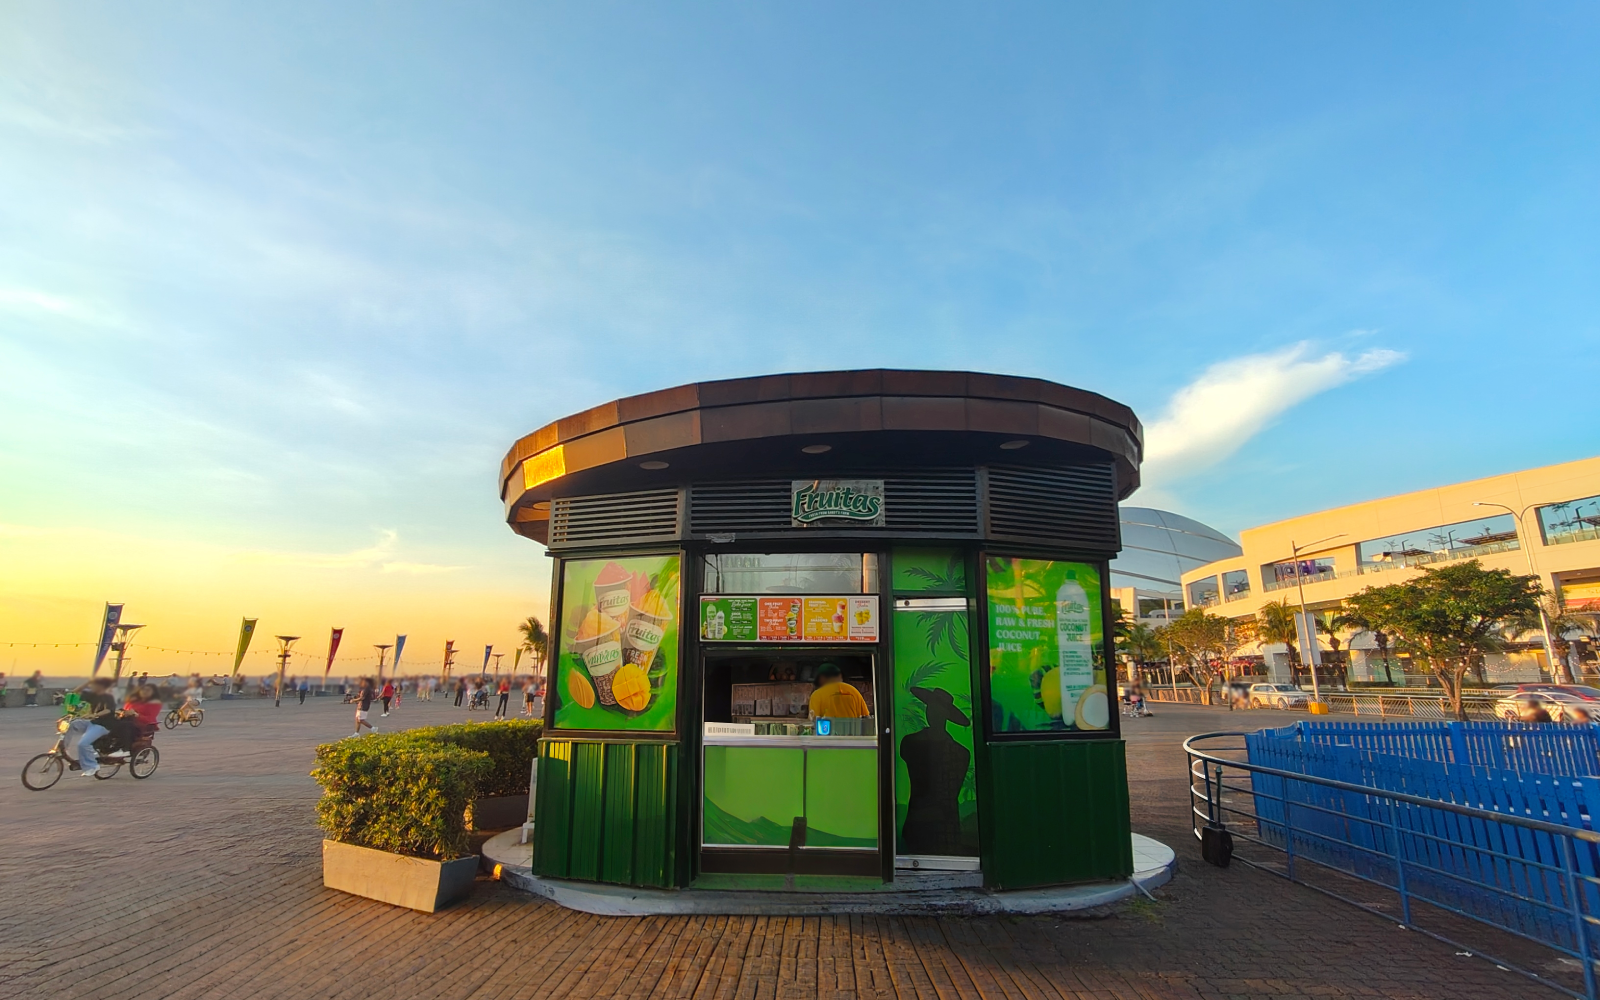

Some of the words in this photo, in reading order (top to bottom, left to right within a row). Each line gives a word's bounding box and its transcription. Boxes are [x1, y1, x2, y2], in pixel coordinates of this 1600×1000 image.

[792, 483, 882, 520] Fruitas
[995, 604, 1020, 614] 100%
[995, 617, 1016, 626] RAW
[1019, 618, 1025, 627] &
[1027, 618, 1055, 629] FRESH
[1060, 622, 1088, 632] COCONUT
[627, 622, 660, 644] Fruitas
[995, 629, 1040, 640] COCONUT
[1066, 633, 1084, 642] JUICE
[996, 642, 1023, 652] JUICE
